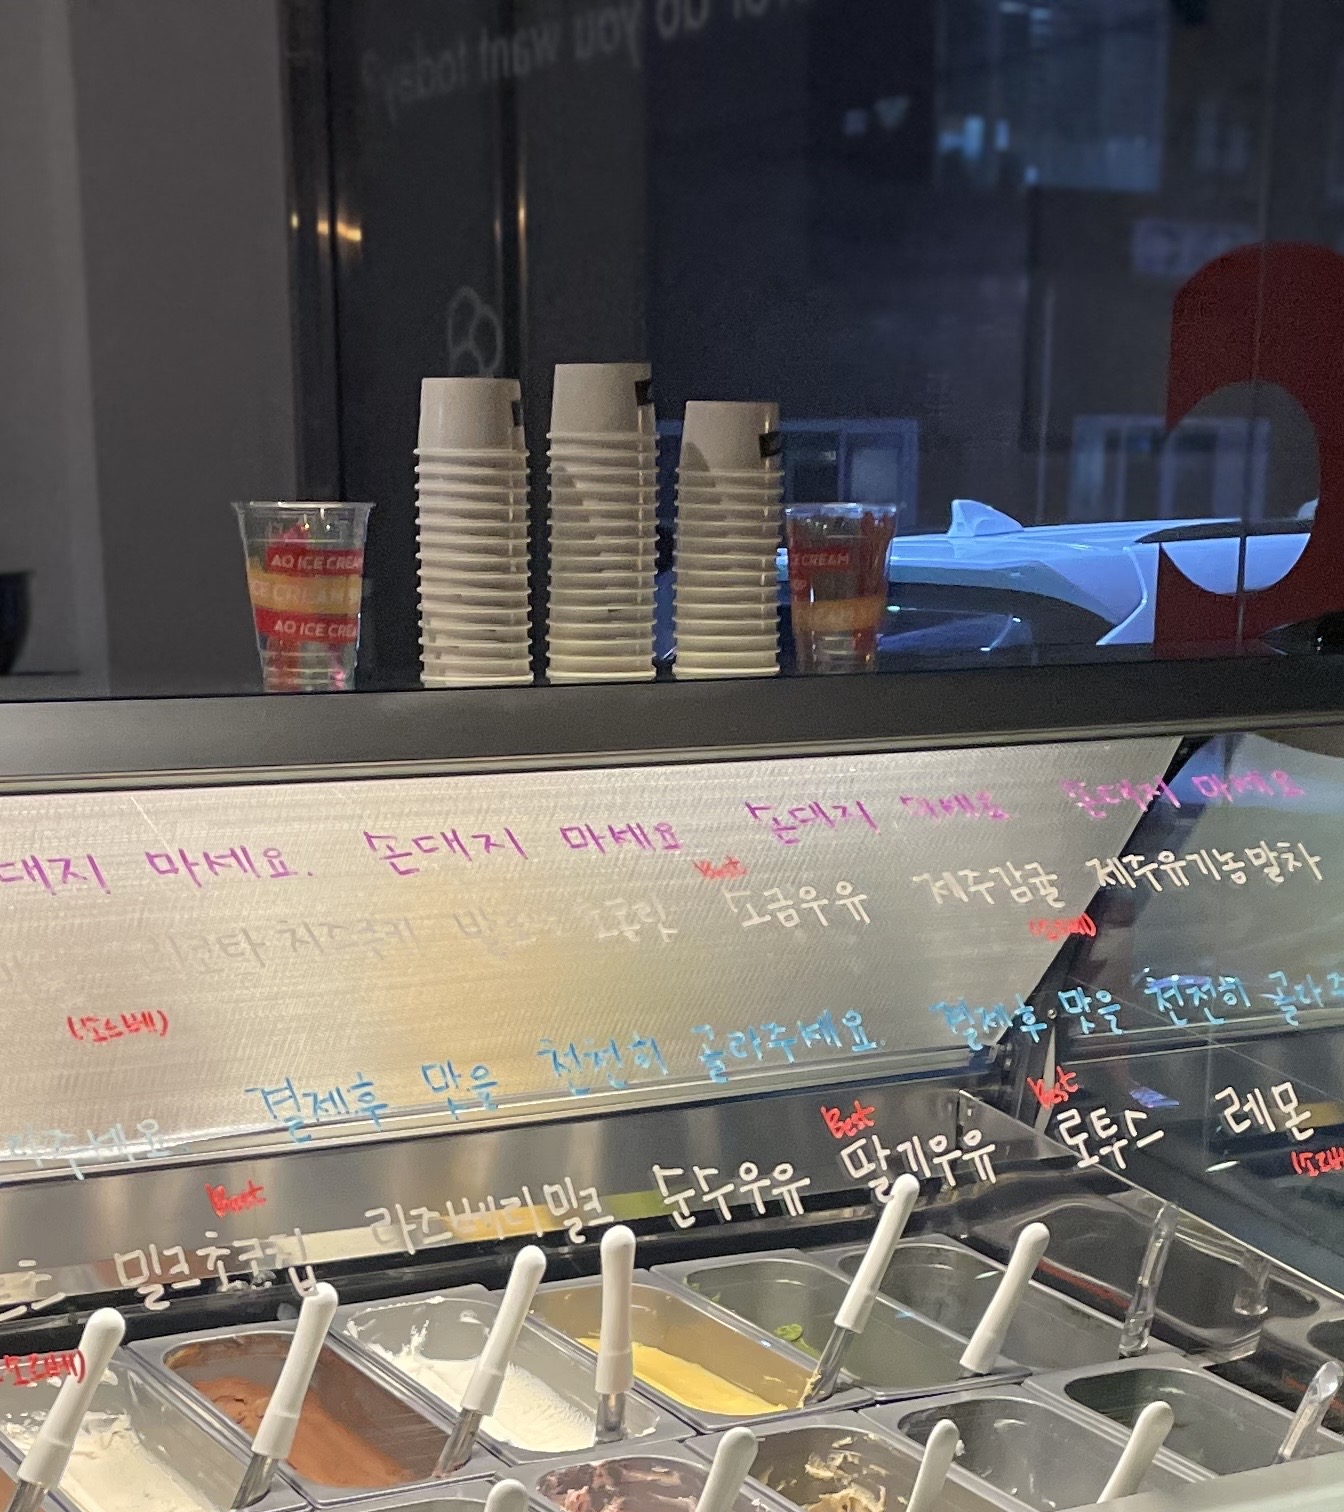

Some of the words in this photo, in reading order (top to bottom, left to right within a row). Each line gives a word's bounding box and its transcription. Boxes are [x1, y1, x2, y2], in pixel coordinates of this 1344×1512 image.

[364, 827, 530, 876] 손대지
[1084, 840, 1324, 893] 제주유기농말차
[721, 880, 871, 929] 소금우유
[912, 860, 1066, 909] 제주감귤
[1057, 986, 1125, 1037] 맛을
[245, 1070, 390, 1147] 결제후
[421, 1060, 500, 1122] 맛을
[537, 1028, 670, 1097] 천천히
[1214, 1080, 1315, 1142] 레몬
[820, 1100, 877, 1140] Best
[1056, 1106, 1165, 1170] 로투스
[839, 1128, 997, 1204] 딸기우유
[652, 1161, 811, 1230] 순수우유
